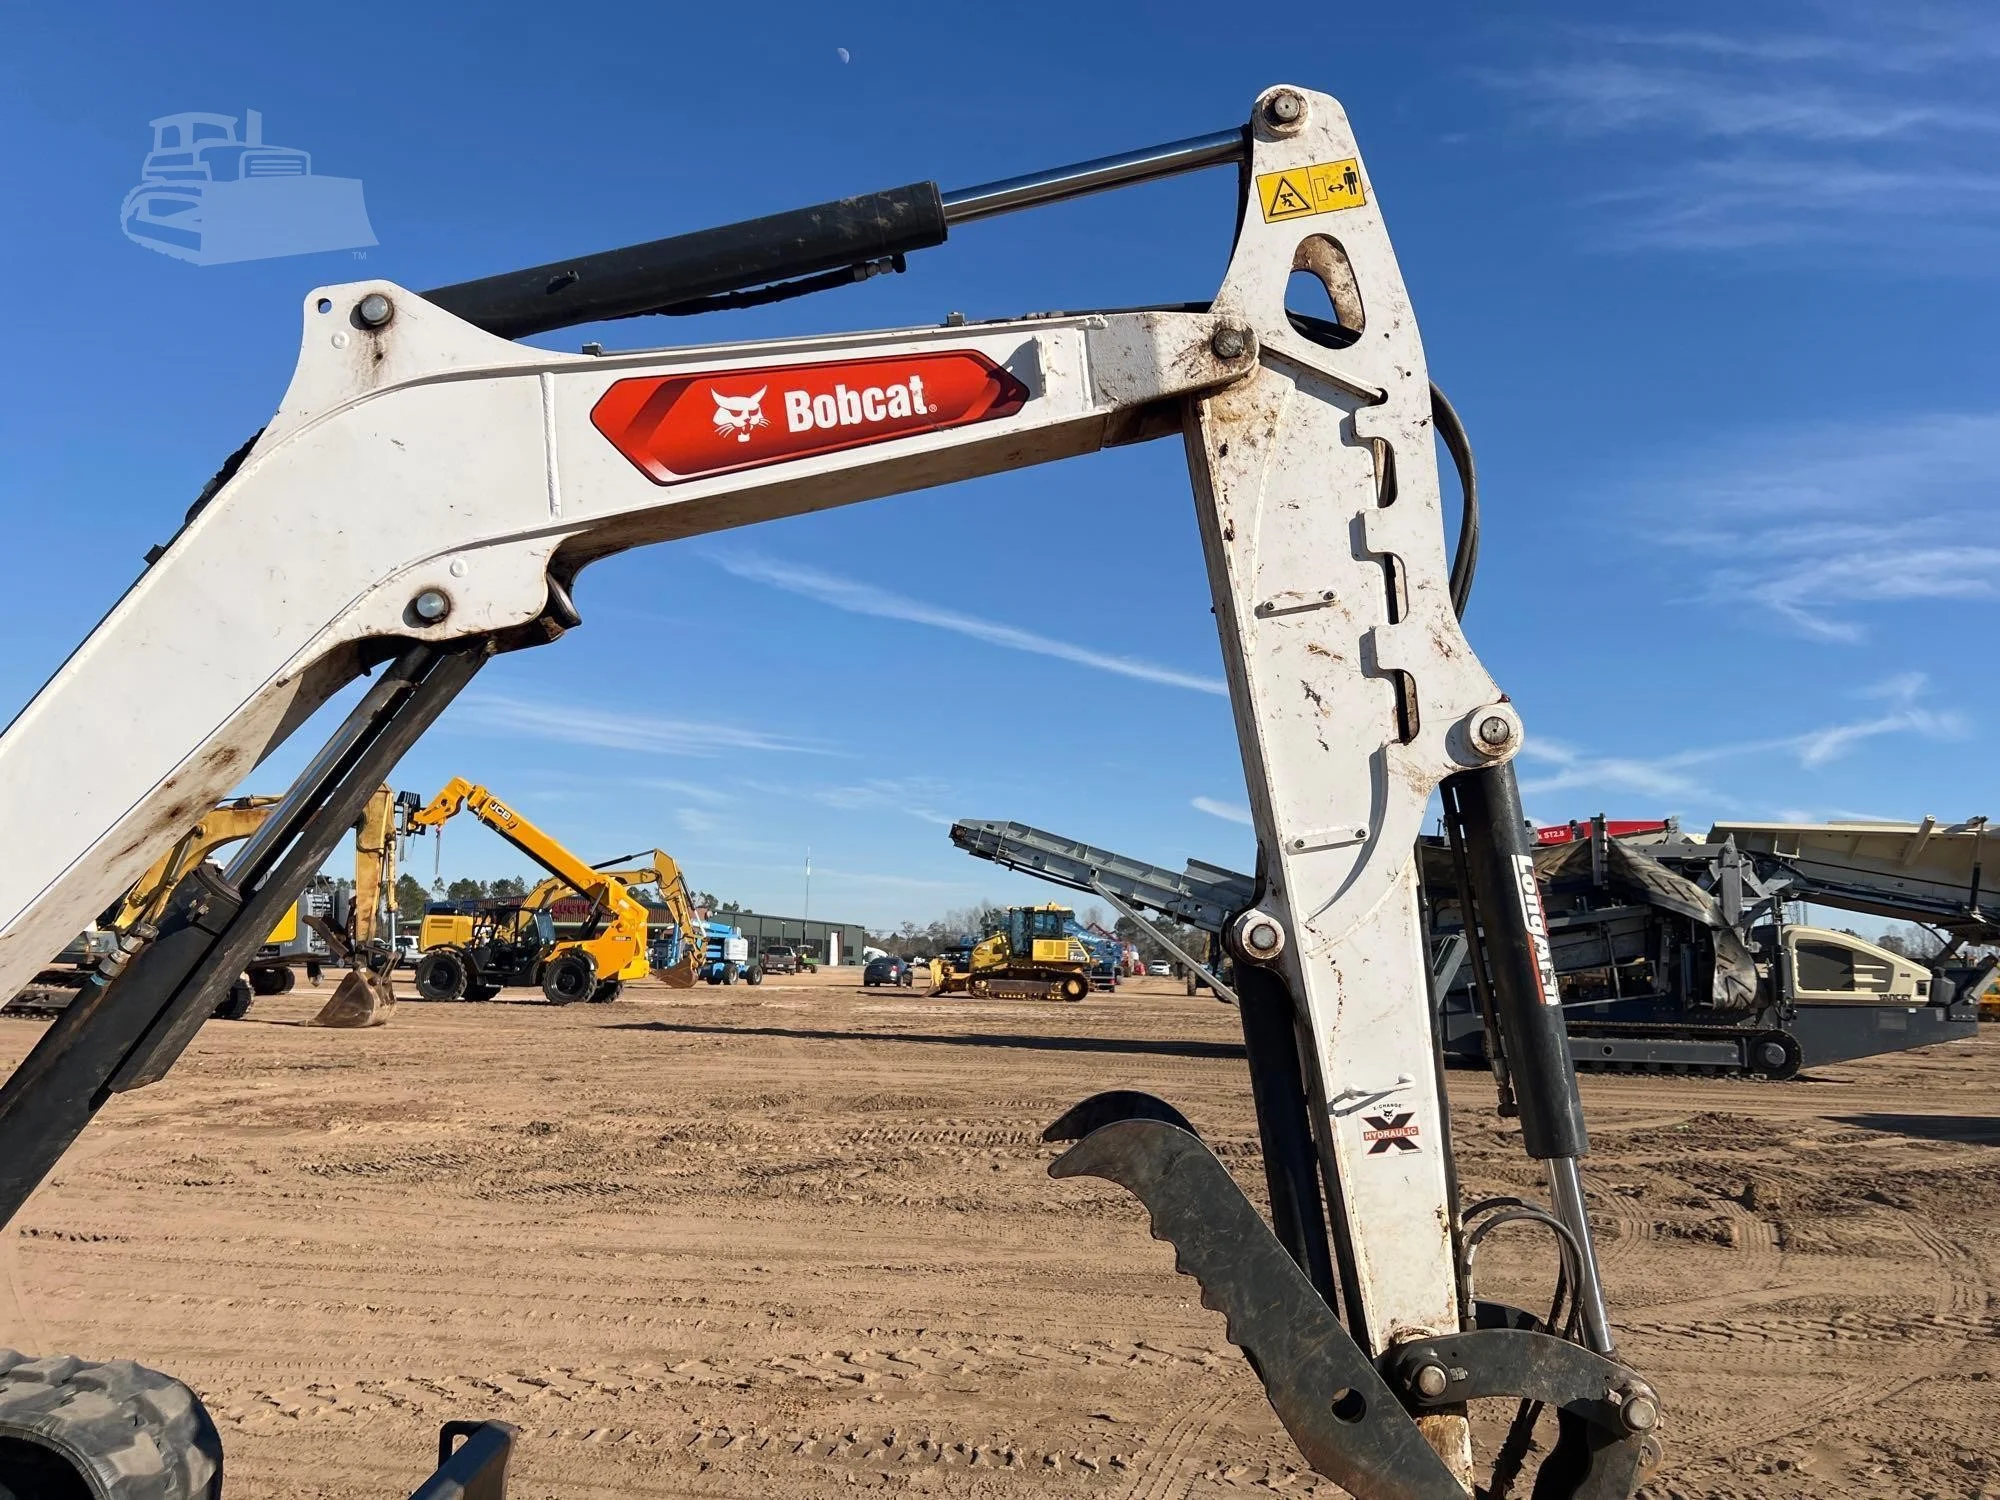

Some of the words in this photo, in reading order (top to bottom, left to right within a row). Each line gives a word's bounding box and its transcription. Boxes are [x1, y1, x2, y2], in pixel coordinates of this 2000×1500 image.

[784, 374, 929, 433] Bobcat
[489, 802, 512, 821] JCB
[1364, 1127, 1418, 1141] HYDRAULIC
